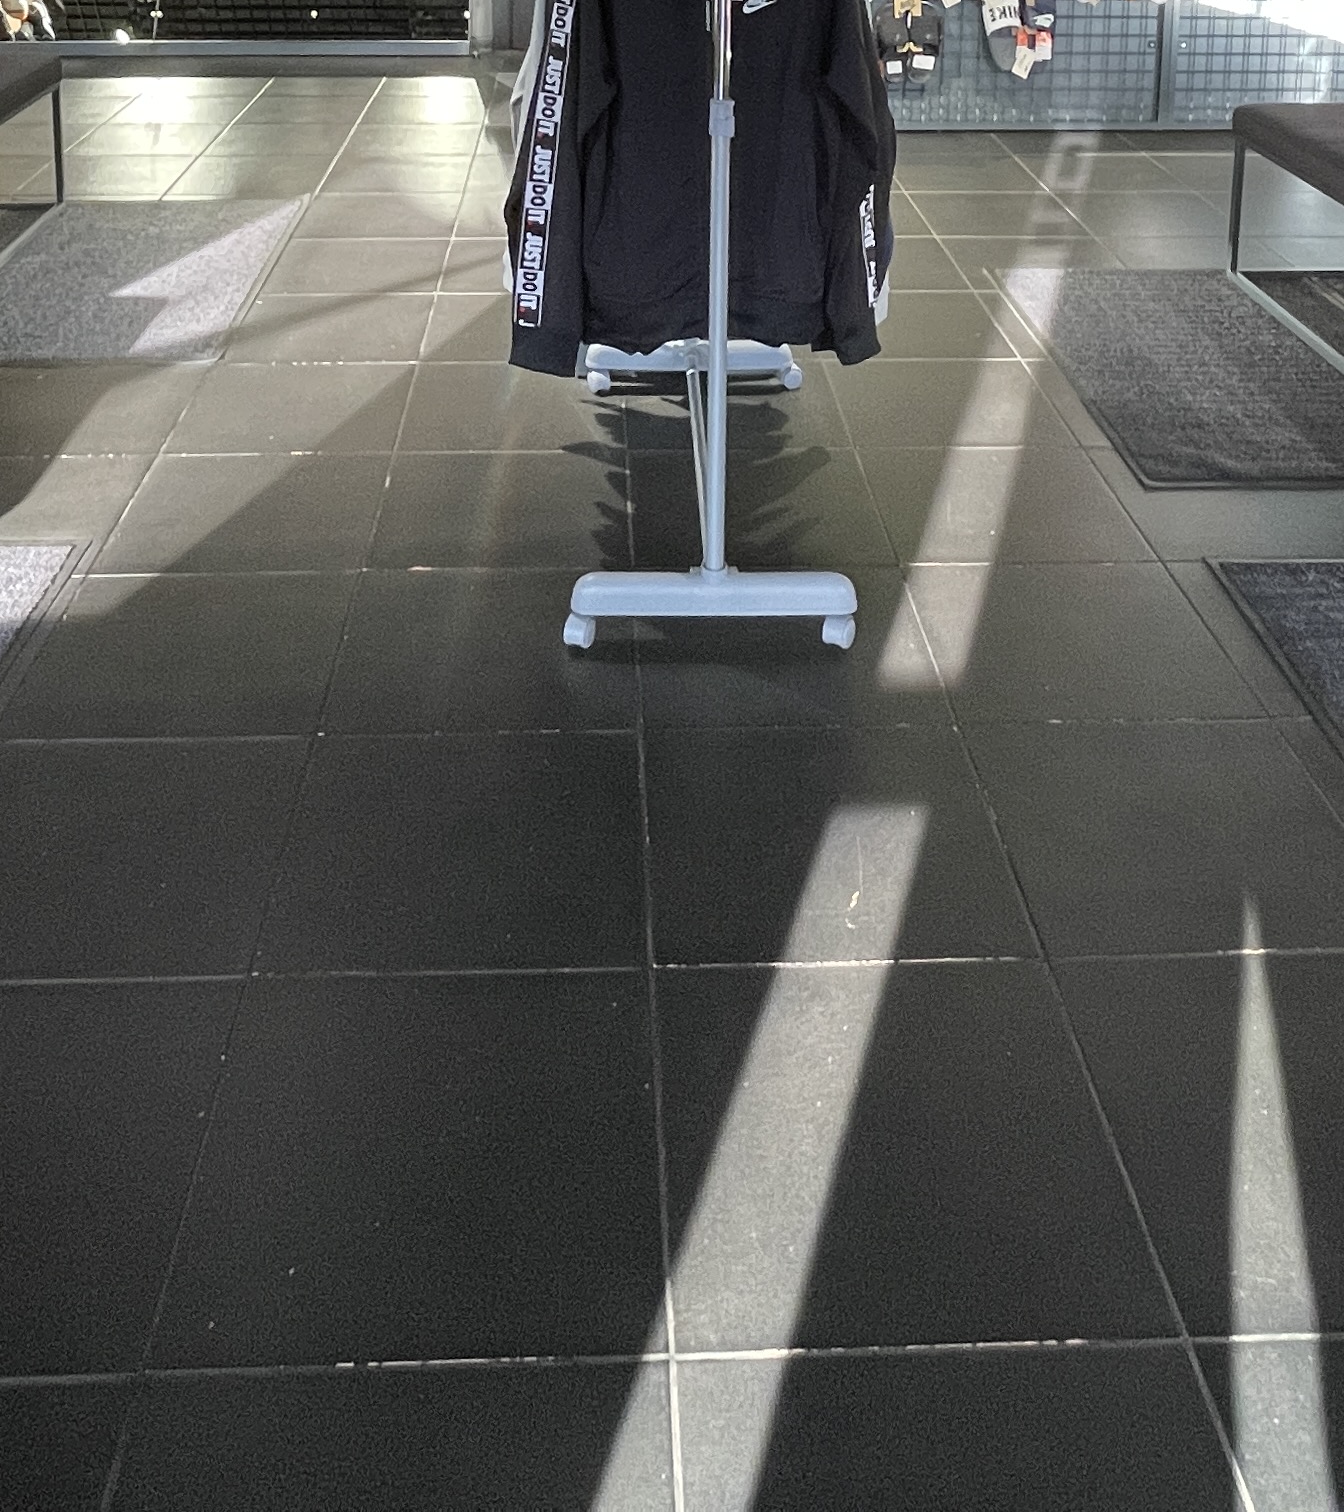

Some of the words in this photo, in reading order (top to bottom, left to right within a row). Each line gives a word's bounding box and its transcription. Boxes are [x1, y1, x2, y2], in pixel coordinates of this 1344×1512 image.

[554, 6, 569, 29] DO
[544, 55, 564, 95] JUST
[541, 94, 557, 119] DO
[532, 144, 553, 183] JUST
[530, 183, 549, 207] DO
[522, 231, 543, 270] JUST
[522, 271, 538, 292] DO
